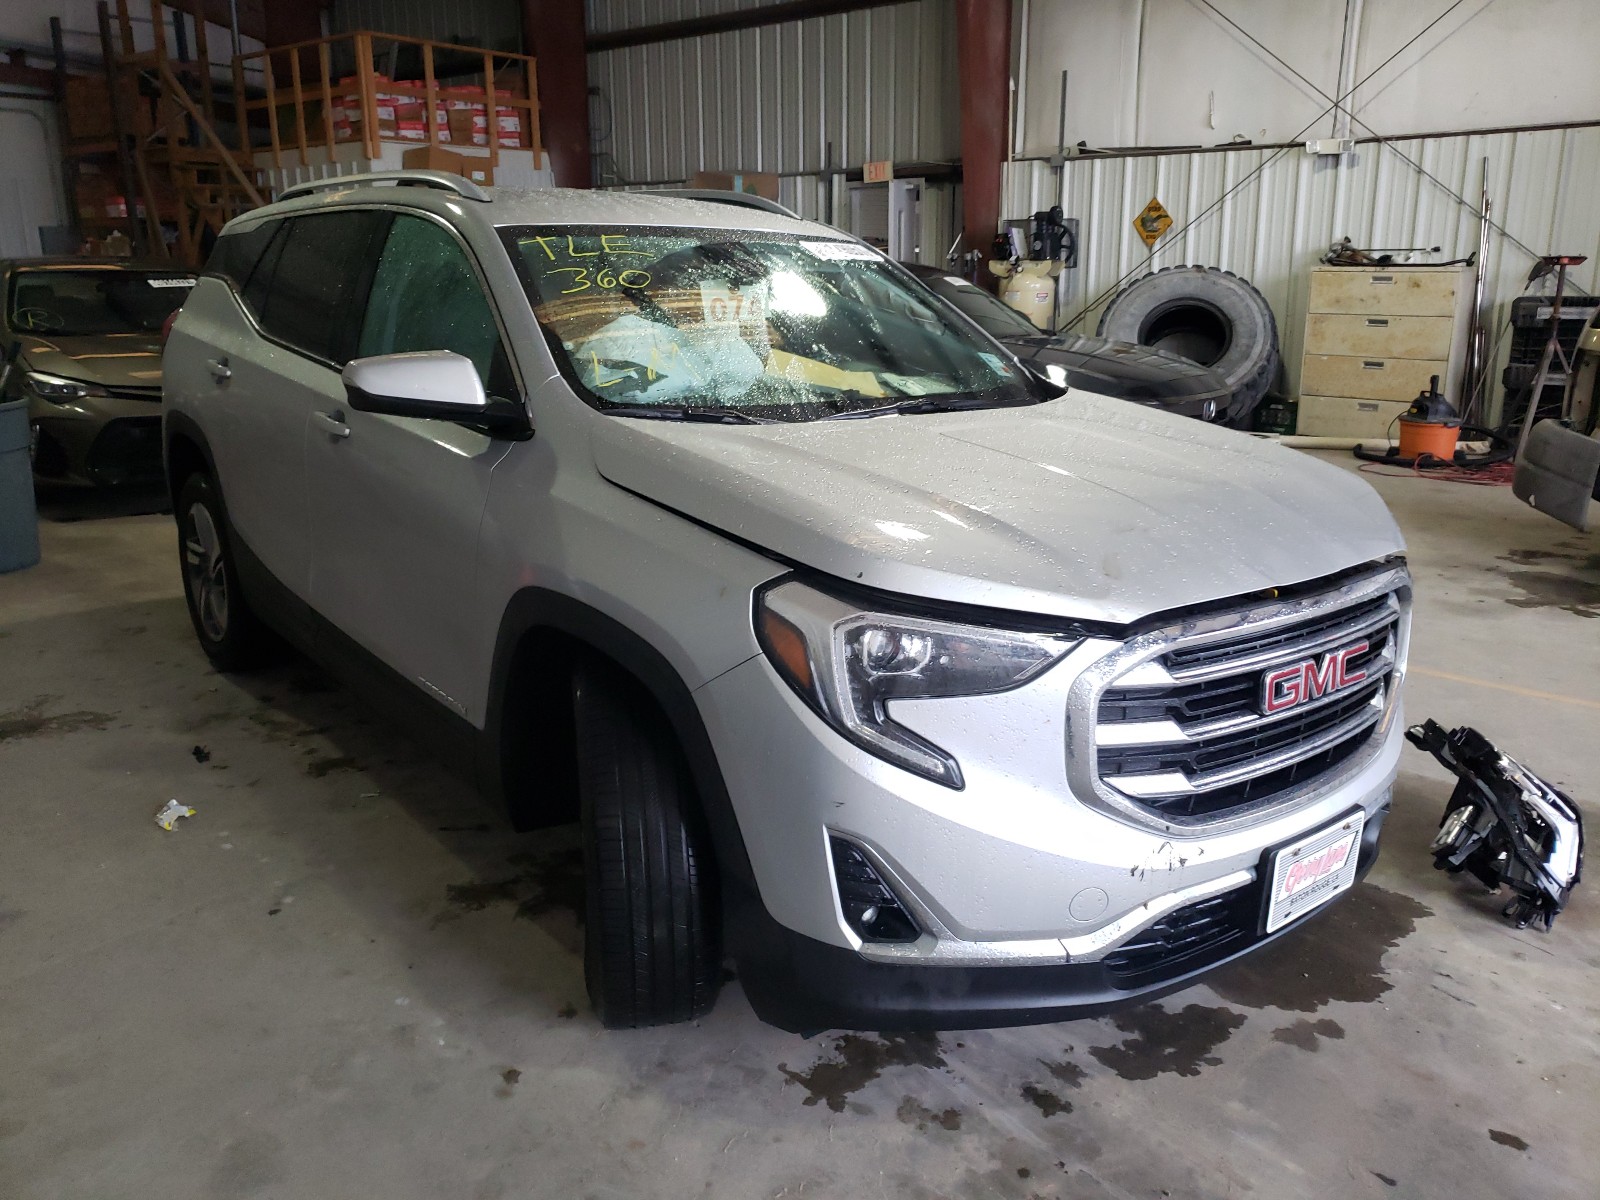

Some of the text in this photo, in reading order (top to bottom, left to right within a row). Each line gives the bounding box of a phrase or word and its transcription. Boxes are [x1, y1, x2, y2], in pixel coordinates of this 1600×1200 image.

[518, 234, 655, 260] TLE
[546, 267, 652, 294] 360
[1264, 640, 1369, 715] GMC
